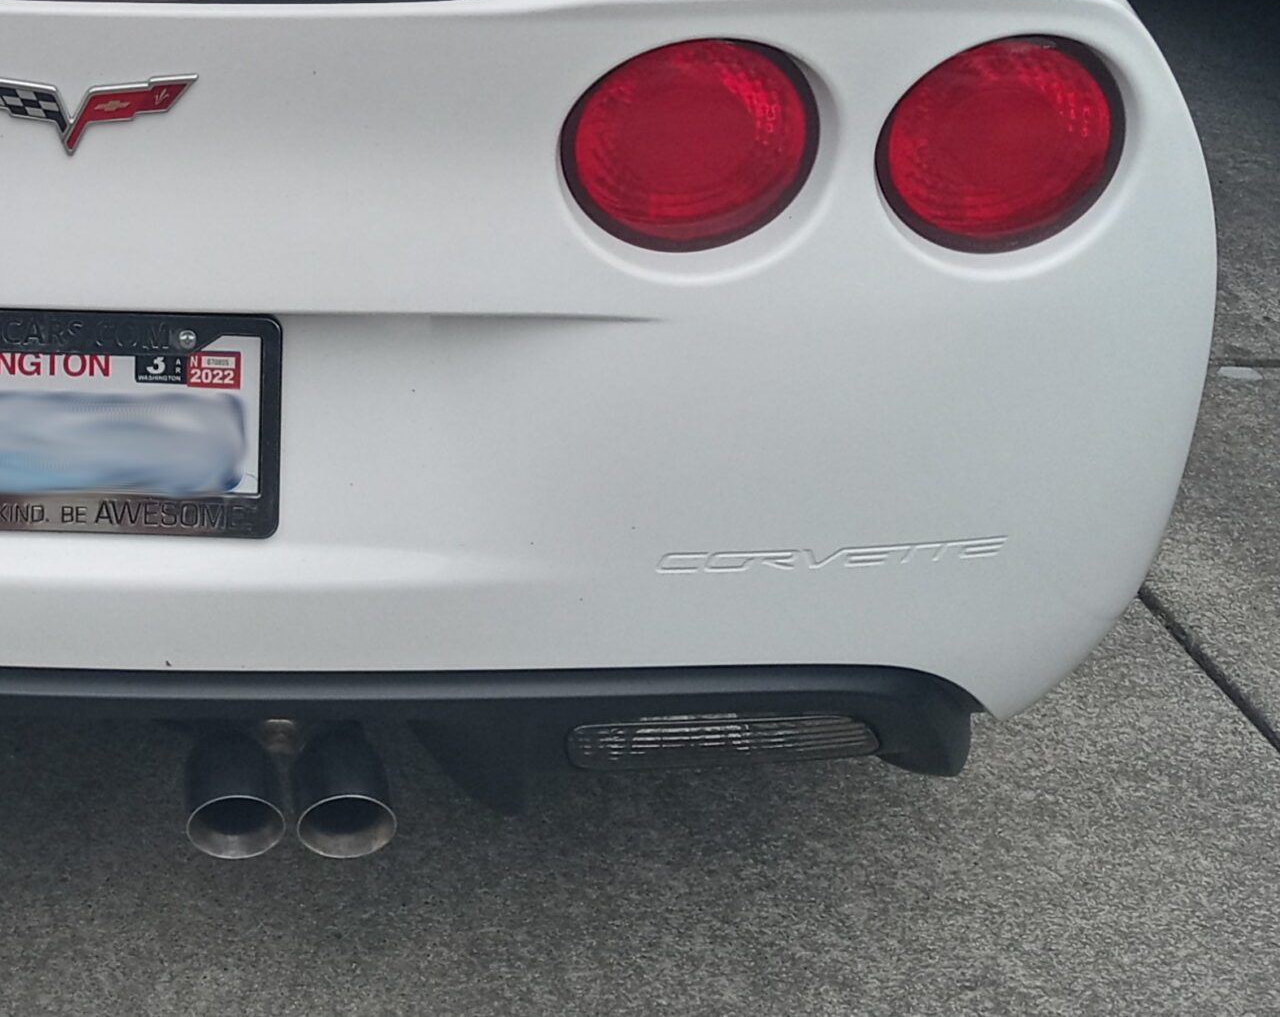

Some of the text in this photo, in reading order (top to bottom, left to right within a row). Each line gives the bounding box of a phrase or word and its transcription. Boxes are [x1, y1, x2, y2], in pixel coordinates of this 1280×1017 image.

[190, 368, 235, 384] 2022
[61, 505, 88, 524] BE
[656, 535, 1009, 574] CORVETTE
